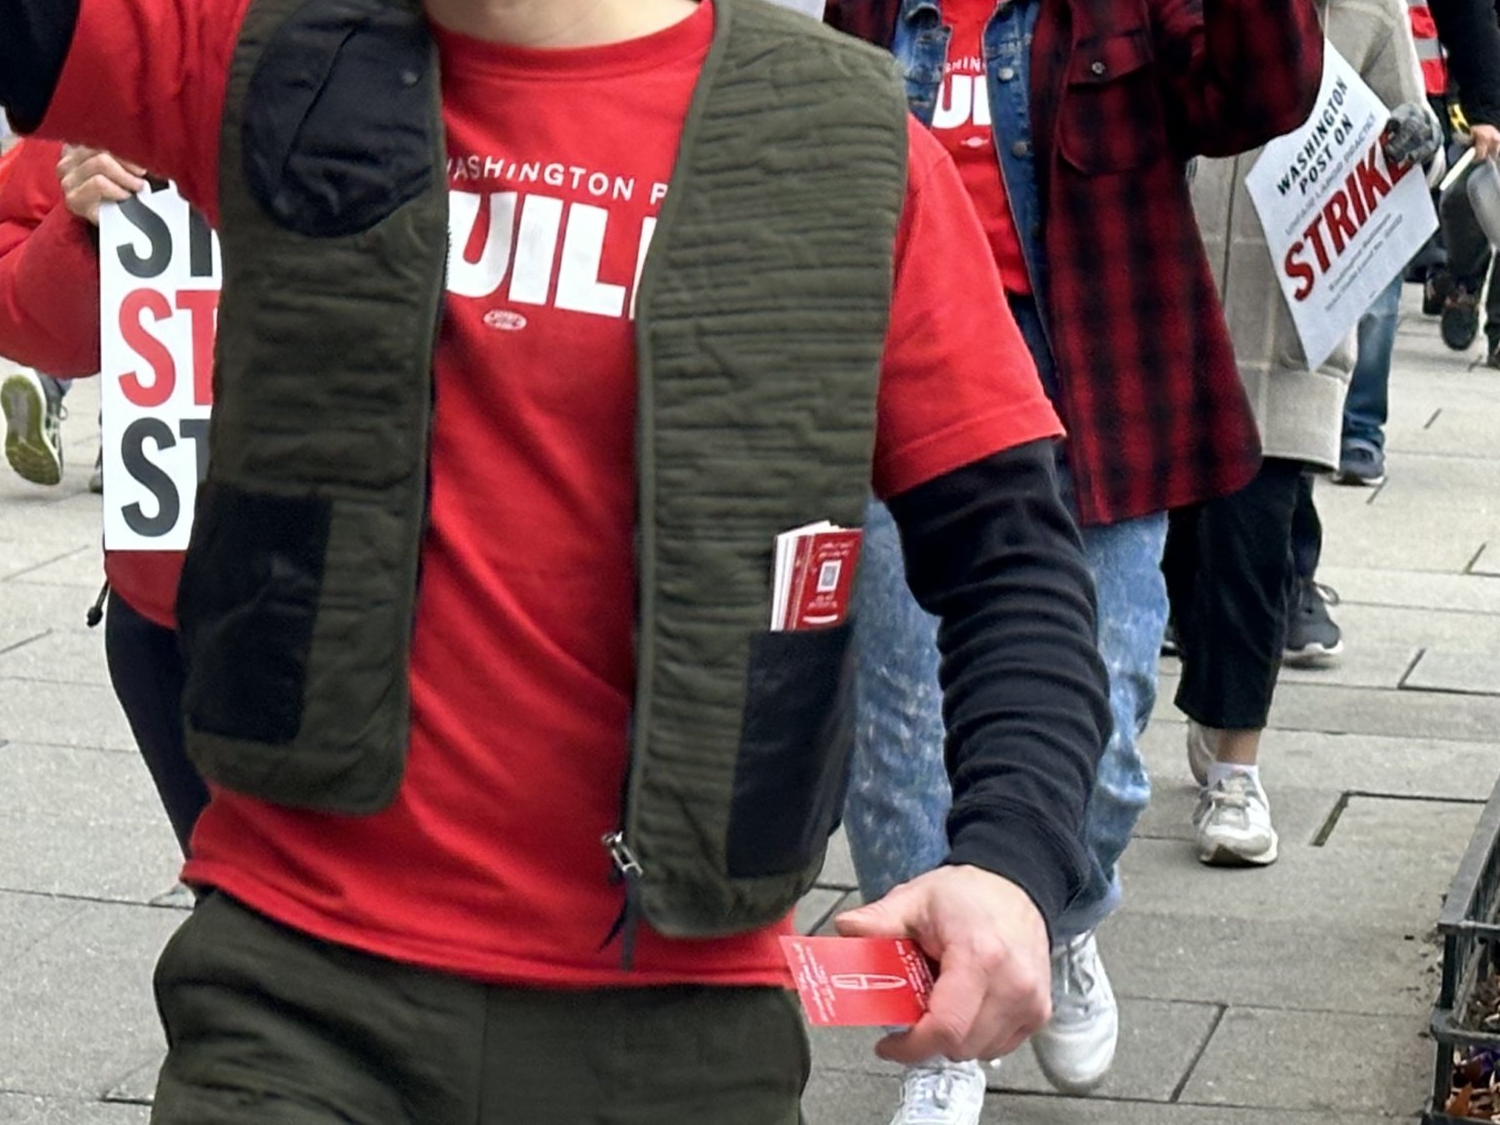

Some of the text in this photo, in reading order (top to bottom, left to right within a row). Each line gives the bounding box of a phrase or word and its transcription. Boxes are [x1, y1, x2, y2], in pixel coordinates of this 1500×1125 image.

[1276, 75, 1348, 197] WASHINGTON
[1299, 114, 1355, 196] POST ON
[447, 155, 635, 201] ASHINGTON
